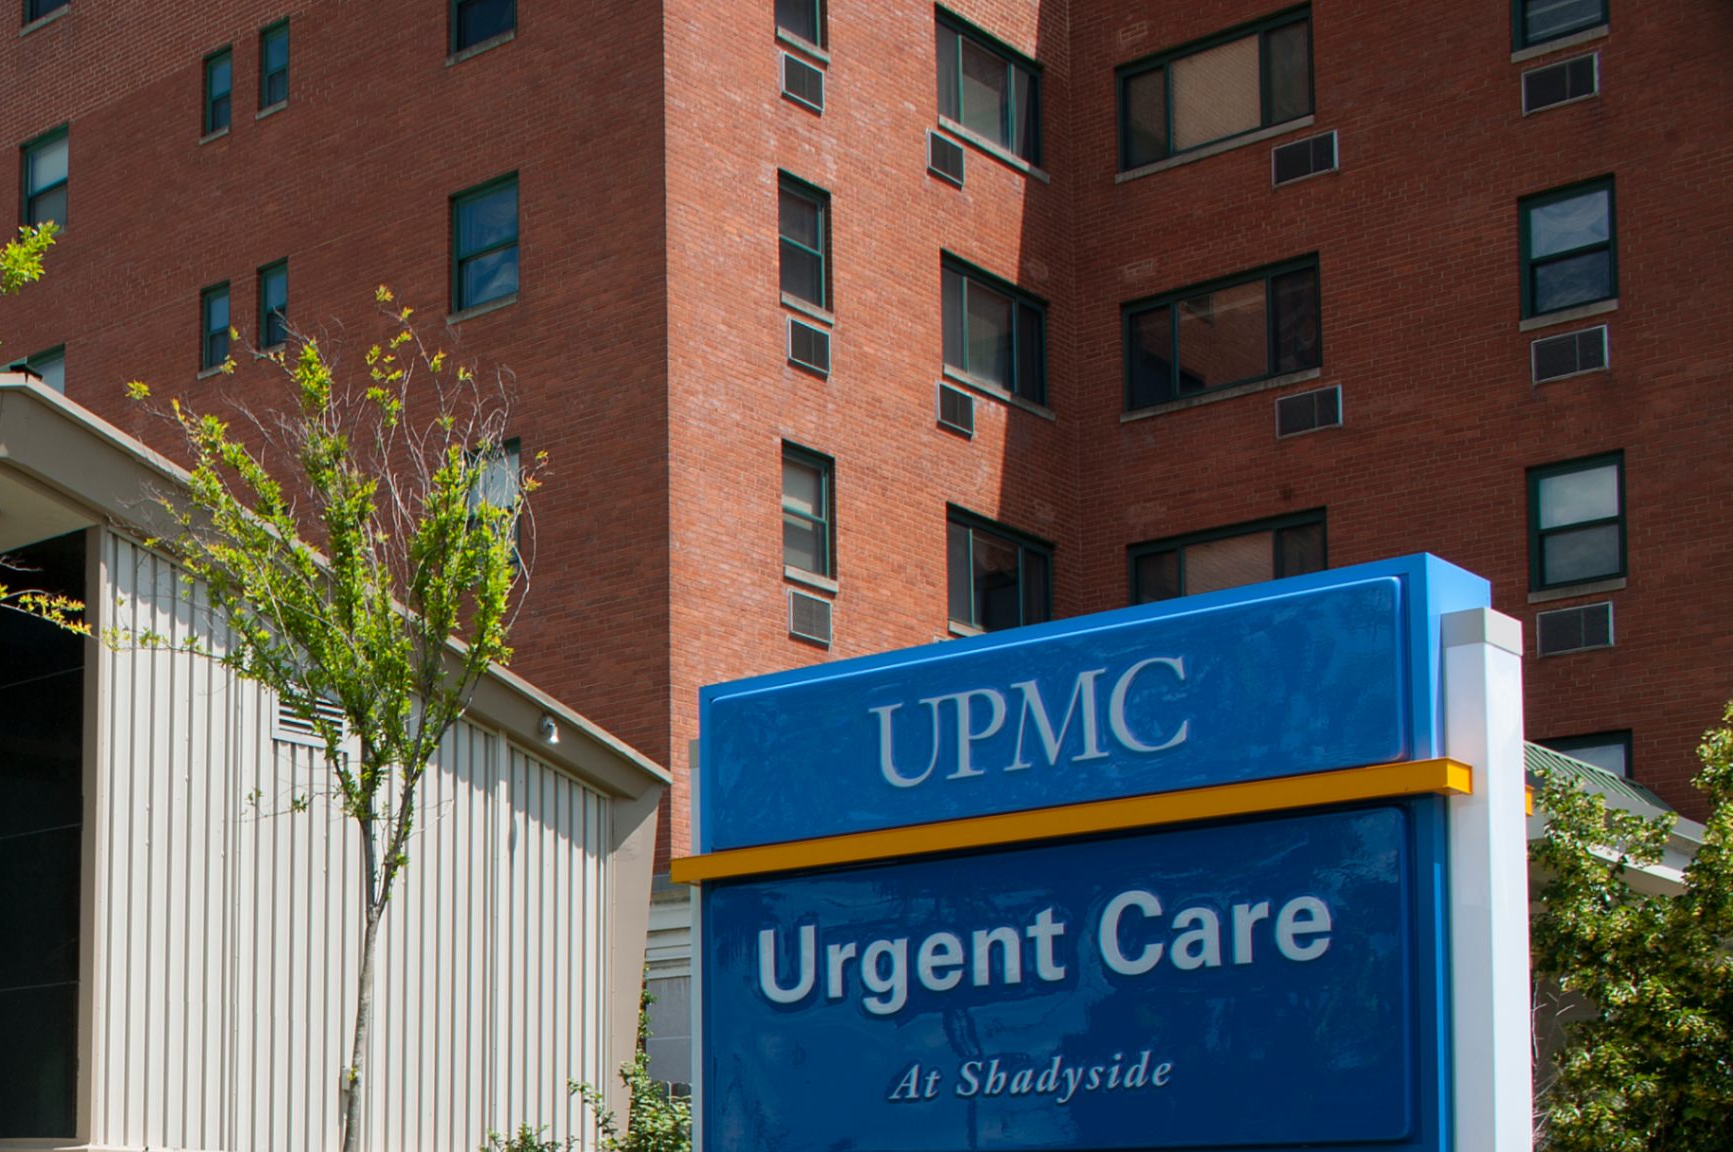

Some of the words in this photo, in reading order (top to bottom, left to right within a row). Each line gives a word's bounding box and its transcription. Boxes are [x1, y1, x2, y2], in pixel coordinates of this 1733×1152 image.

[869, 655, 1188, 789] UPMC
[757, 907, 1066, 1015] Urgent
[1097, 889, 1333, 976] Care
[889, 1063, 941, 1100] At
[955, 1050, 1173, 1105] Shadyside
